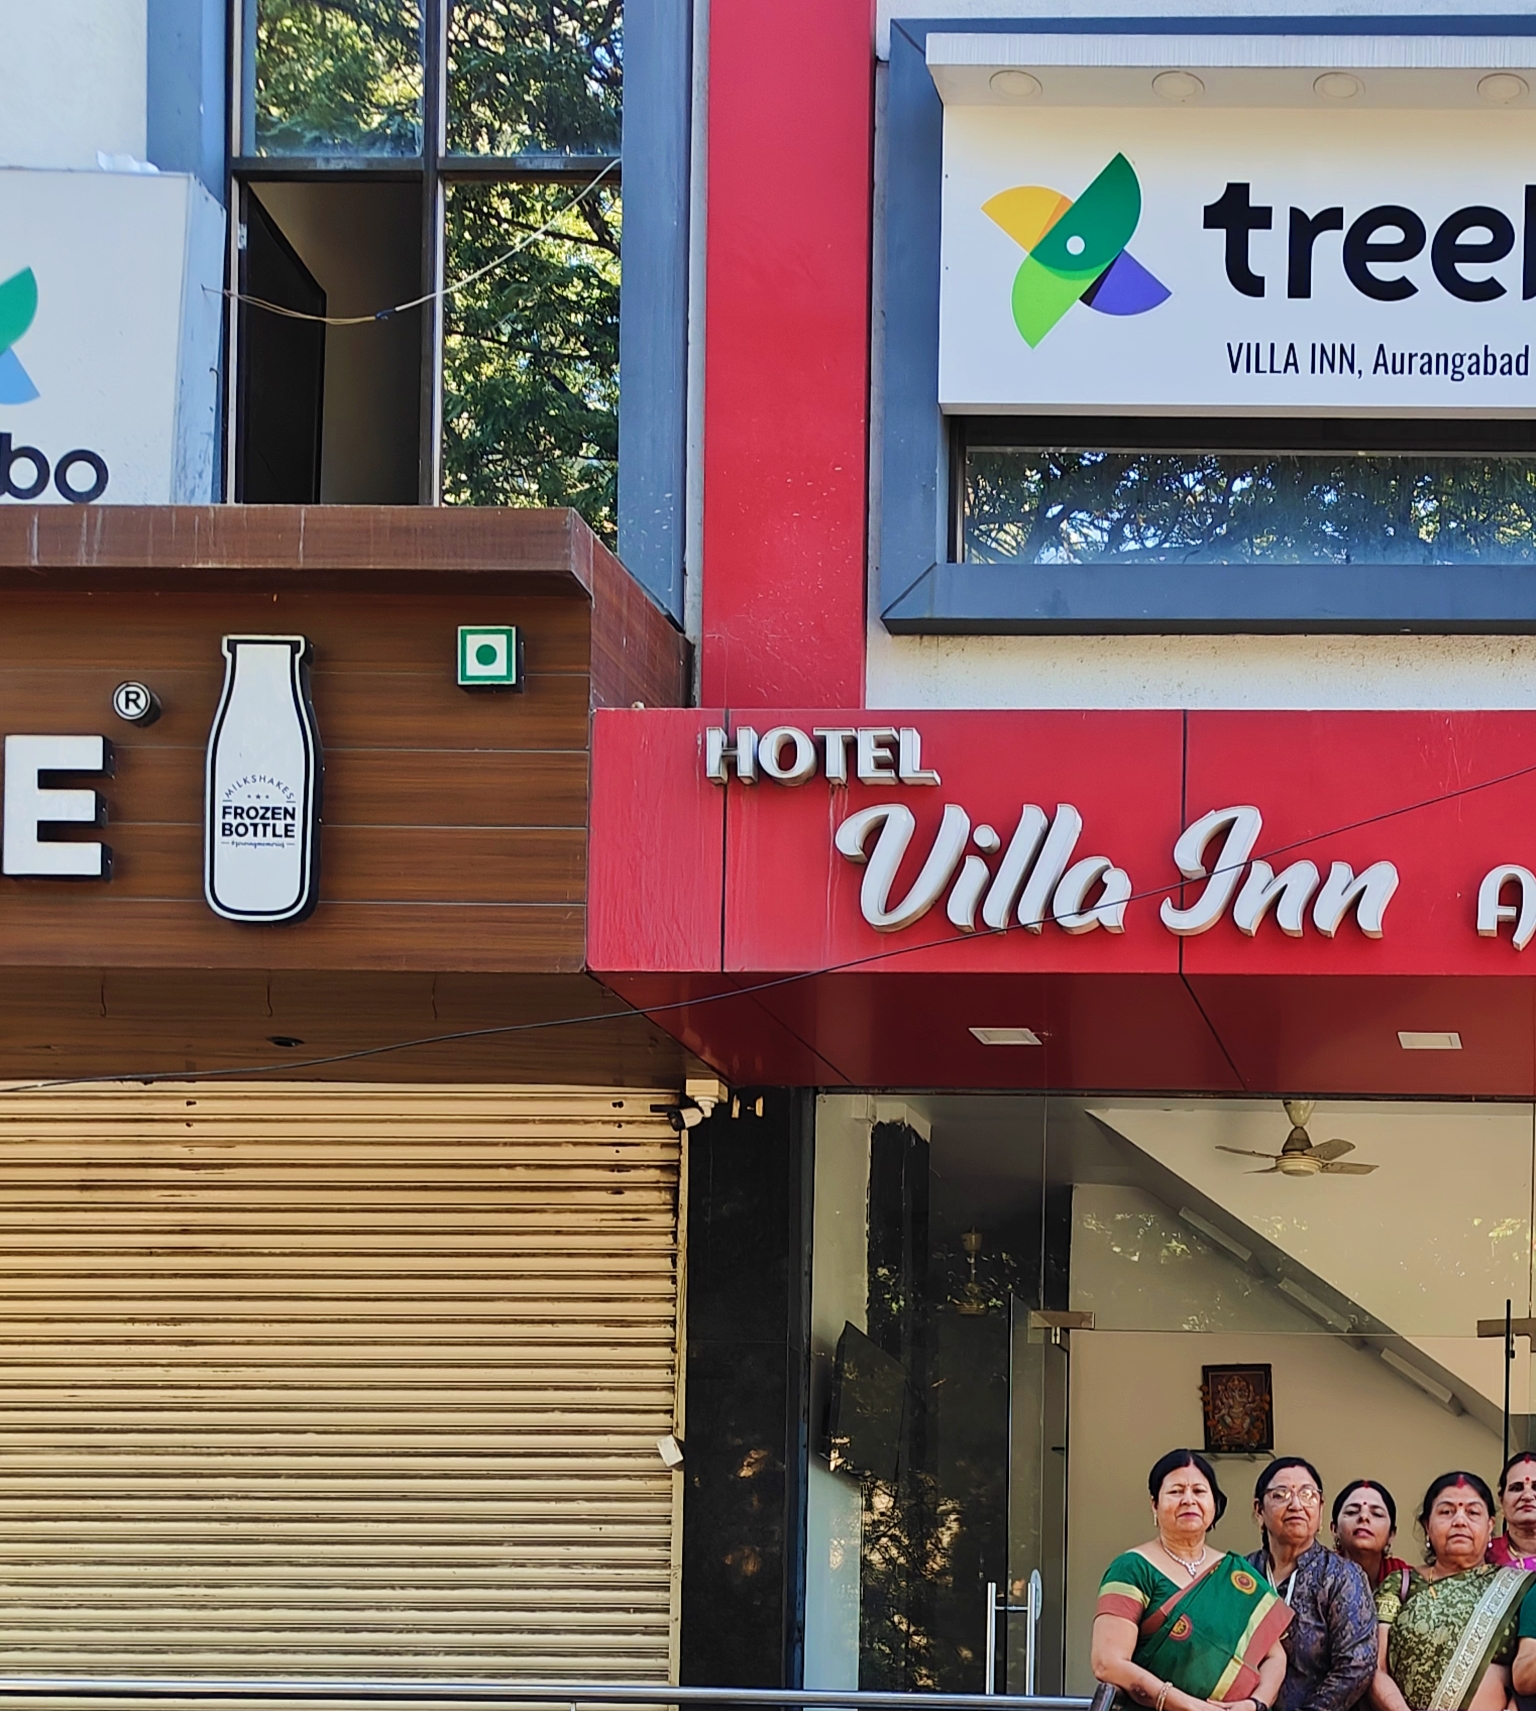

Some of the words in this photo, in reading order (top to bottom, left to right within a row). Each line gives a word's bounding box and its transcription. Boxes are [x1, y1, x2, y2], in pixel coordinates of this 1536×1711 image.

[1226, 342, 1300, 375] VILLA
[1310, 342, 1363, 380] INN,
[1372, 343, 1530, 382] Aurangabad
[704, 726, 941, 787] HOTEL
[3, 734, 104, 876] E
[224, 774, 295, 801] MILKSHAKES
[221, 805, 297, 821] FROZEN
[221, 822, 296, 839] BOTTLE
[834, 803, 1133, 935] Villa
[1159, 805, 1400, 939] Inn
